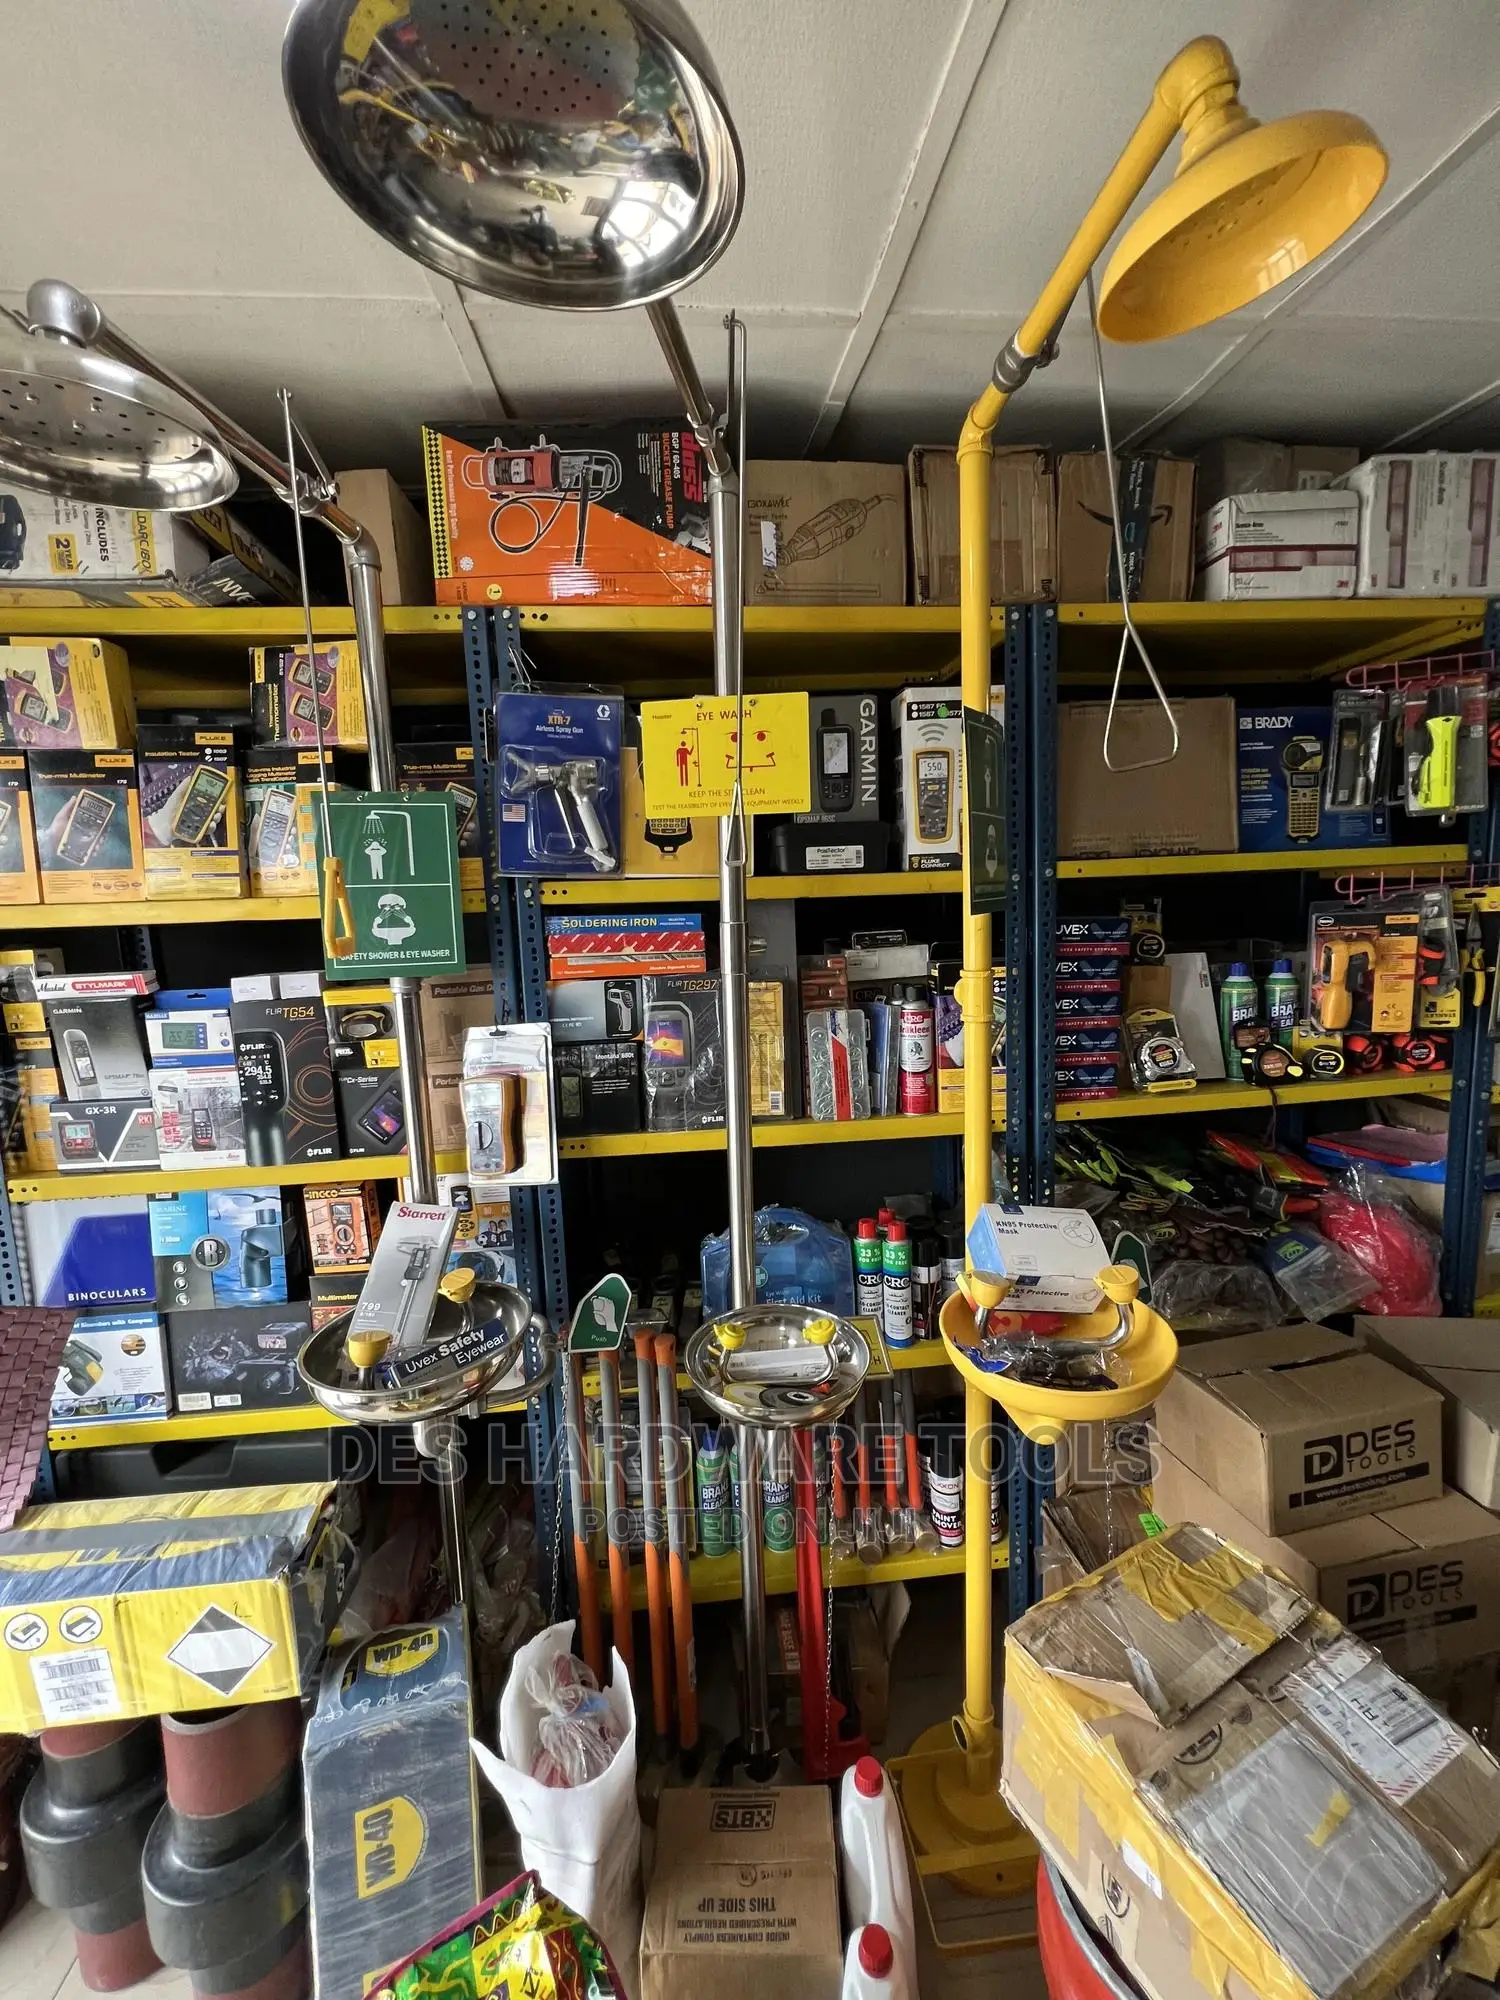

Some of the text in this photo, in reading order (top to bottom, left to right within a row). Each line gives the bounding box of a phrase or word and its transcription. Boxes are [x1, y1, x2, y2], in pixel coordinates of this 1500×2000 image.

[673, 455, 681, 479] 60-405
[662, 432, 674, 529] BUCKET GREASE PUMP
[95, 507, 109, 562] INCLUDES
[55, 537, 74, 570] 2 YEAR
[696, 710, 752, 721] EYE WAH
[1254, 716, 1294, 729] BRADY
[536, 725, 554, 733] Airless
[556, 726, 571, 734] Spray
[859, 698, 878, 806] GARMIN
[688, 789, 707, 798] KEEP
[707, 789, 722, 797] THE
[678, 802, 709, 810] FEASIBILITY
[747, 799, 780, 807] EQUIPMENT
[562, 918, 657, 928] SOLDERING IRON
[368, 950, 399, 960] SHOWER
[400, 950, 406, 959] &
[406, 950, 420, 959] EYE
[420, 949, 450, 958] WASHER
[37, 983, 66, 993] Markal
[75, 981, 128, 990] STYLMARK
[434, 984, 485, 995] Portable Gas
[683, 980, 717, 991] TG297
[265, 1006, 315, 1019] FLIR TG54
[904, 1016, 924, 1024] CRC
[246, 1043, 265, 1051] FLIR
[85, 1106, 117, 1115] GX-3R
[137, 1115, 153, 1125] RKI
[313, 1148, 333, 1156] FLIR
[309, 1187, 338, 1200] INGCO
[397, 1206, 446, 1221] Starrett
[1019, 1222, 1058, 1230] Protective
[885, 1250, 896, 1258] 33
[884, 1276, 911, 1288] CRC
[68, 1287, 147, 1301] BINOCULARS
[1026, 1289, 1070, 1297] Protective
[790, 1296, 805, 1305] Aid
[808, 1293, 822, 1303] Kit
[361, 1302, 381, 1311] 799
[591, 1334, 607, 1343] Push
[404, 1328, 485, 1374] Uvex Safety
[455, 1334, 505, 1365] Eyewear
[1346, 1419, 1416, 1458] DES
[1347, 1446, 1416, 1472] TOOLS
[1390, 1560, 1464, 1596] DES
[1391, 1587, 1463, 1613] TOOLS
[373, 1632, 434, 1662] WD-40
[363, 1807, 396, 1889] WD-40
[698, 1897, 776, 1912] THIS SIDE UP
[677, 1918, 797, 1928] WITH PRESCRIBED REGULATIONS
[684, 1932, 790, 1942] INSIDE CONTAINERS COMPLY
